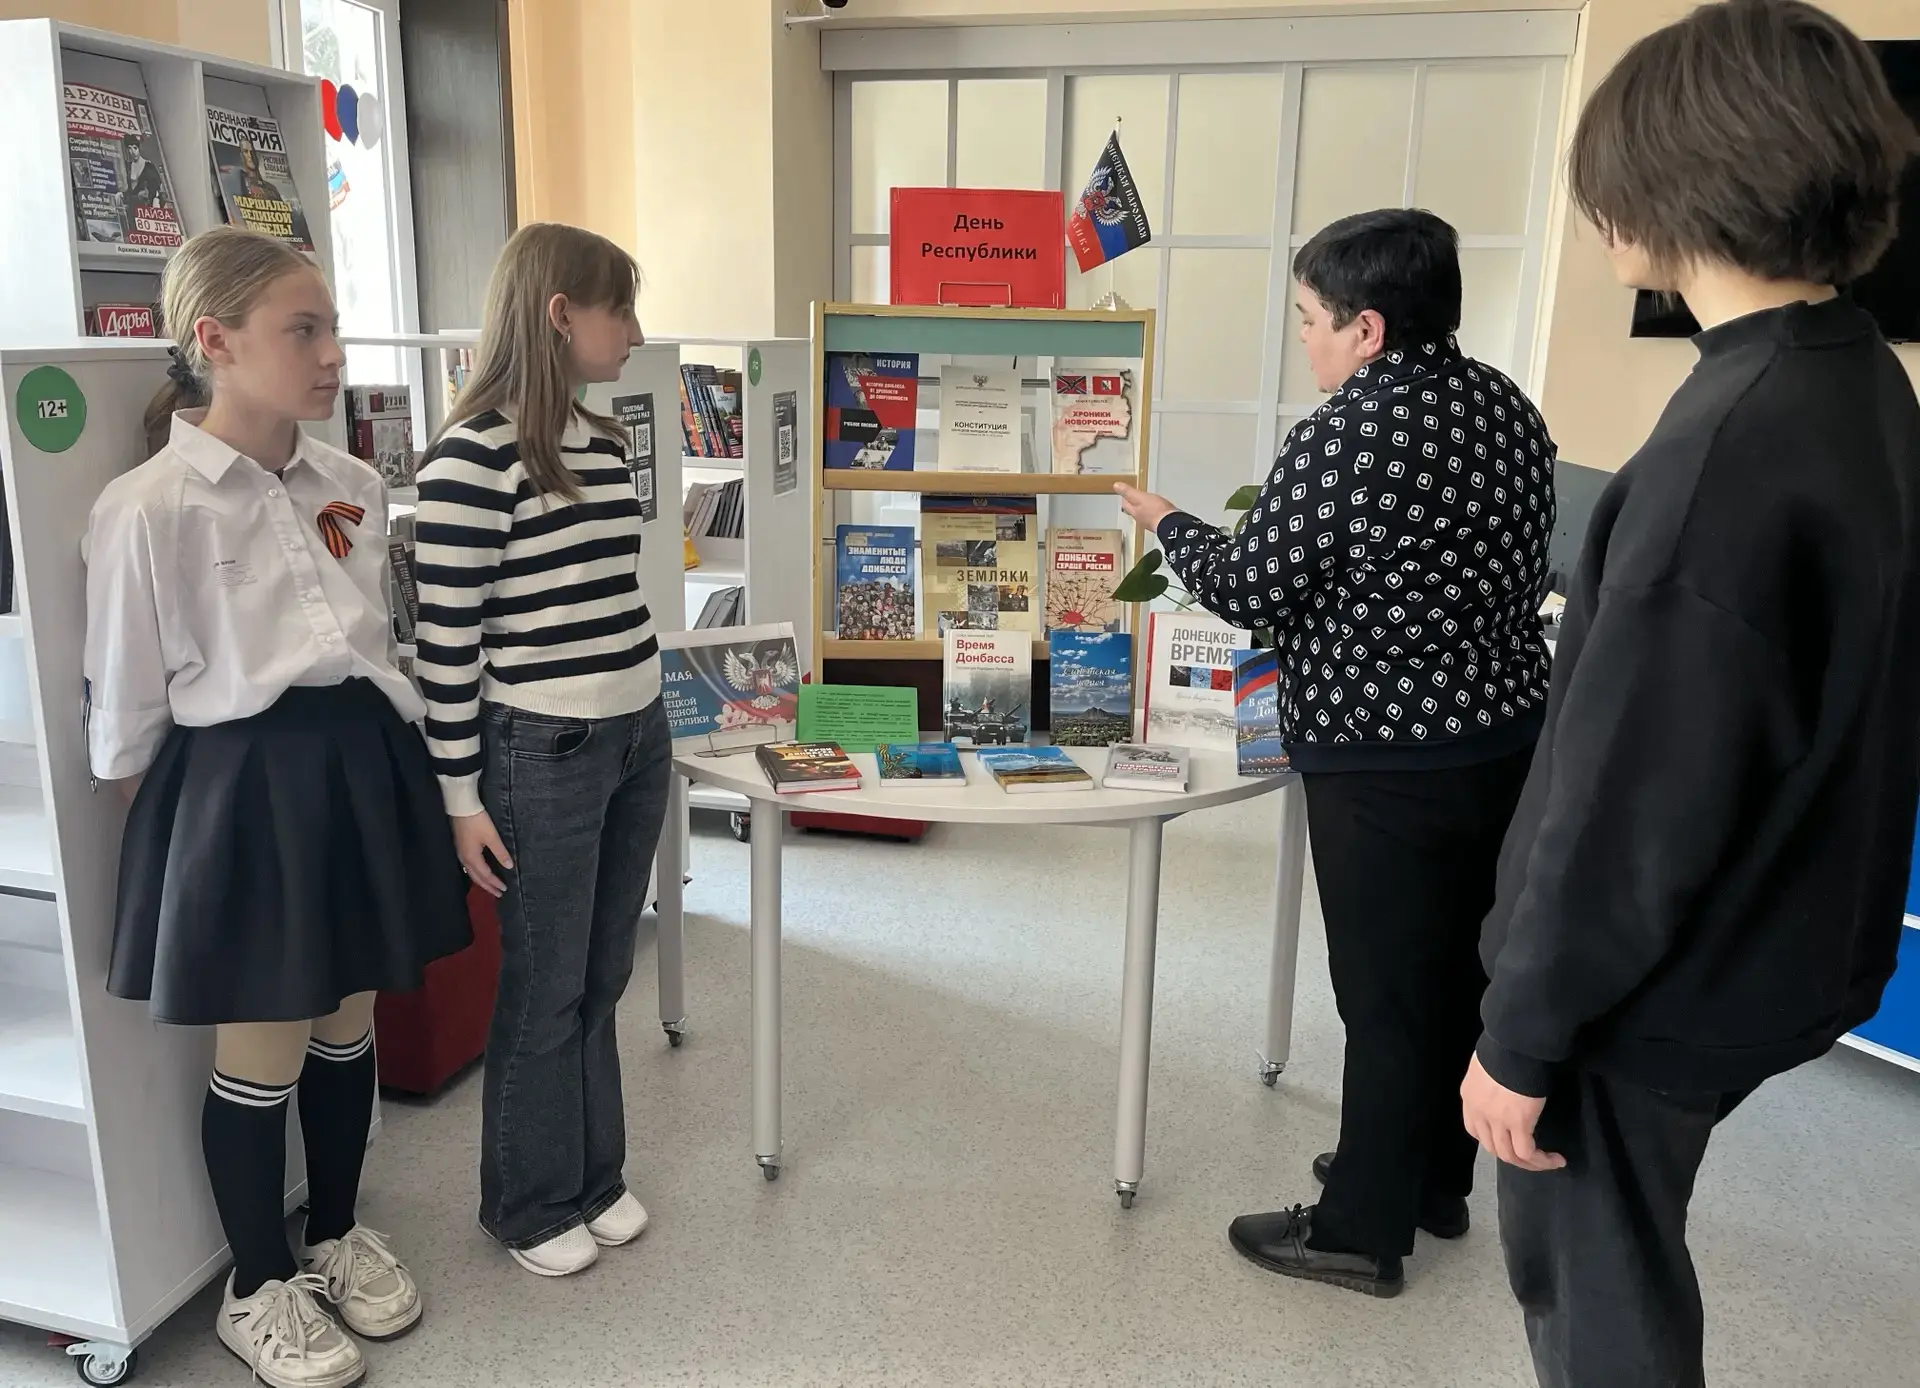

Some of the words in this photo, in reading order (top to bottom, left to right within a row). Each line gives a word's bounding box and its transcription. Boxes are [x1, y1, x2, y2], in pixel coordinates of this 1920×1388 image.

[64, 86, 133, 112] АРХИВЫ
[95, 111, 138, 131] ВЕКА
[207, 108, 248, 128] ВОЕННАЯ
[209, 121, 282, 151] ИСТОРИЯ
[1106, 141, 1130, 188] ОНЕЦКАЯ
[1124, 188, 1147, 239] НАРОДНАЯ
[233, 195, 292, 212] МАРШАЛЫ
[137, 207, 174, 220] ЛАЙЗА:
[240, 208, 292, 224] ВЕЛИКОЙ
[136, 220, 150, 230] 80
[155, 222, 179, 233] ЛЕТ
[246, 220, 293, 236] ПОБЕДЫ
[953, 214, 1004, 232] День
[921, 243, 1037, 262] Республики
[105, 311, 150, 337] Дарья
[876, 359, 911, 369] ИСТОРИЯ
[38, 400, 67, 418] 12+
[954, 421, 1008, 431] КОНСТИТУЦИЯ
[848, 546, 906, 556] ЗНАМЕНИТЫЕ
[1058, 553, 1097, 562] ДОНБАСС
[880, 556, 906, 565] ЛЮДИ
[861, 565, 906, 574] ДОНБАССА
[957, 569, 1029, 582] ЗЕМЛЯКИ
[1172, 628, 1236, 645] ДОНЕЦКОЕ
[956, 639, 995, 651] Время
[956, 652, 1014, 664] Донбасса
[1171, 643, 1233, 665] ВРЕМЯ
[665, 670, 693, 683] МАЯ
[662, 690, 680, 700] НЕМ
[1257, 693, 1277, 705] серд
[664, 697, 697, 709] ЕЦКОЙ
[666, 707, 698, 719] ОДНОЙ
[1253, 705, 1278, 720] Дон
